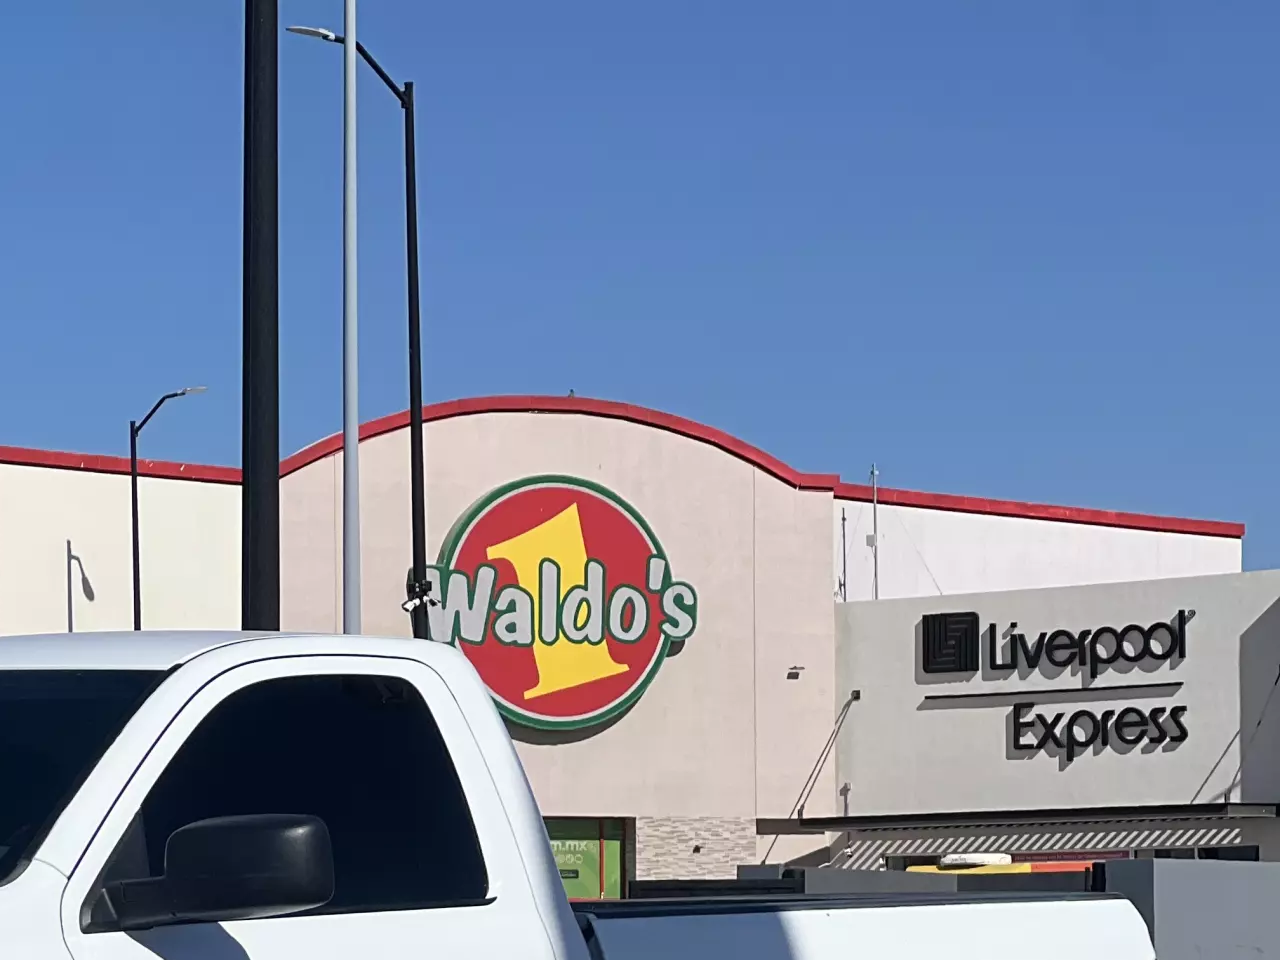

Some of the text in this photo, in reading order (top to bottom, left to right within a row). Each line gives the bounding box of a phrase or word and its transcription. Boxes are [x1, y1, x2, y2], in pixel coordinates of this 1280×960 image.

[410, 553, 698, 647] Waldo's
[989, 609, 1187, 679] Liverpool
[1013, 702, 1189, 762] Express
